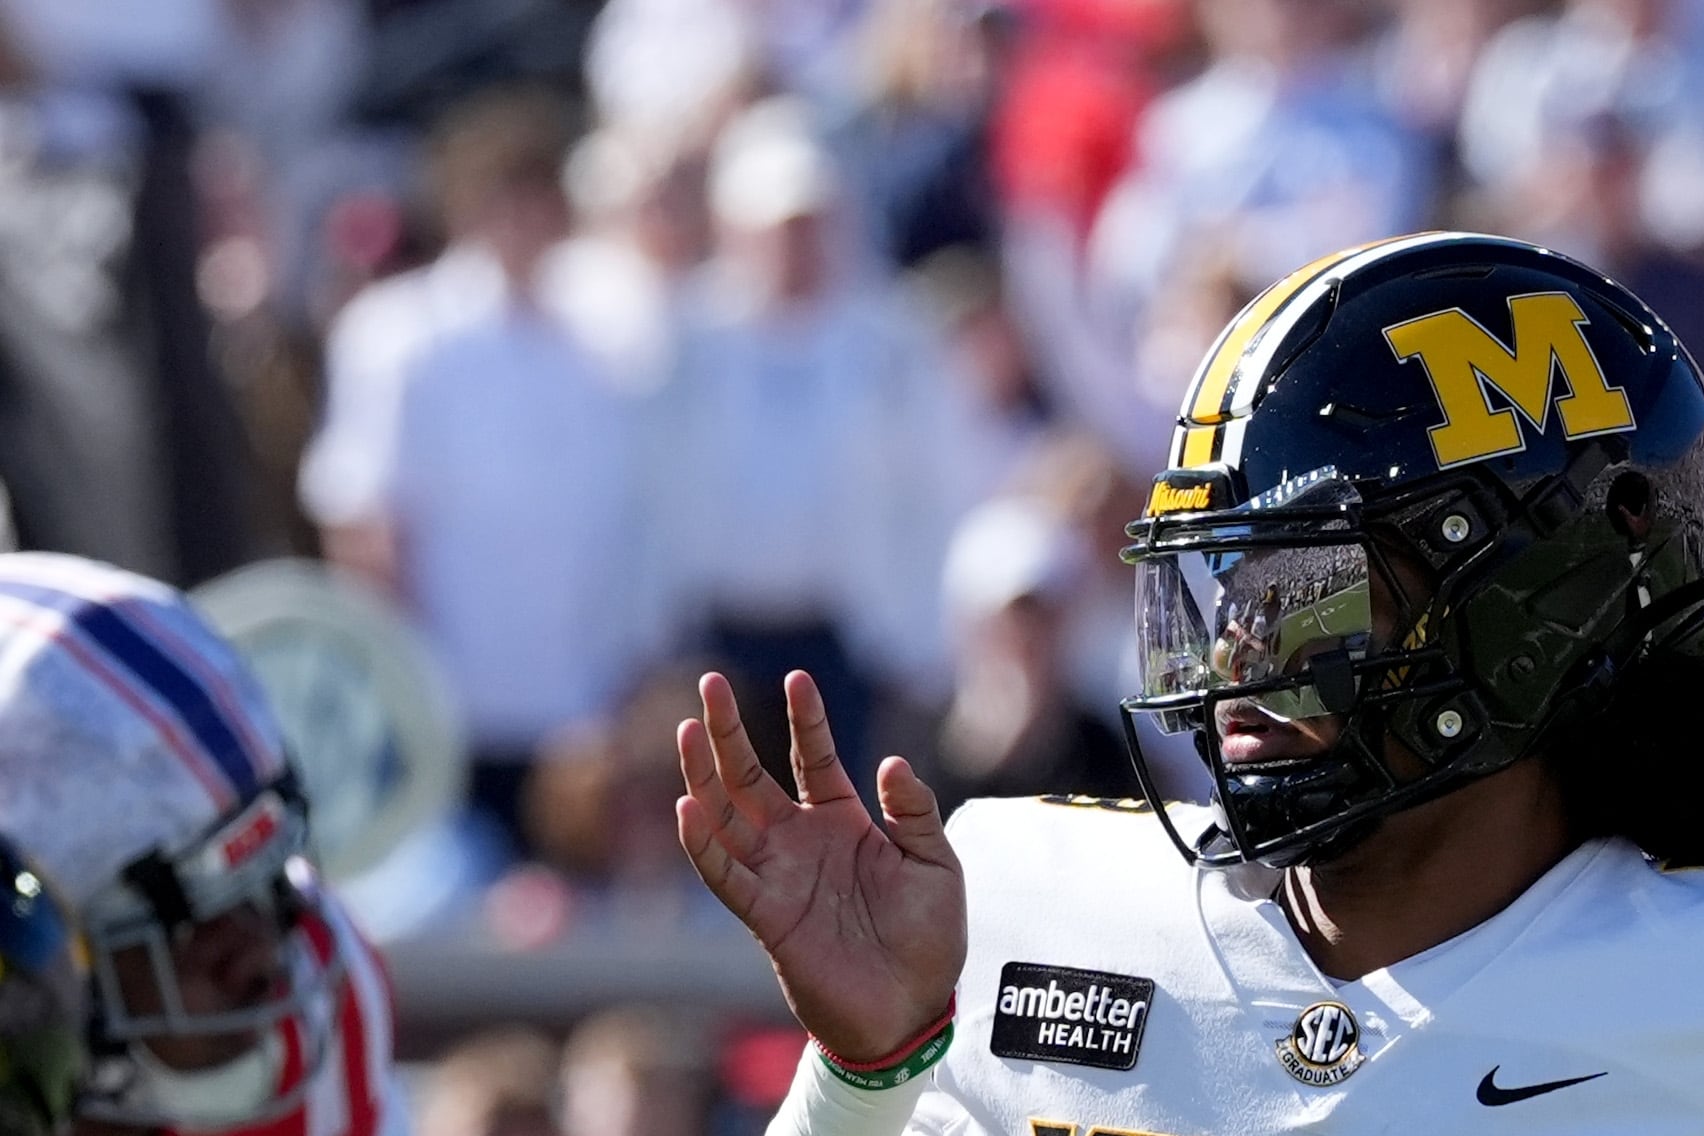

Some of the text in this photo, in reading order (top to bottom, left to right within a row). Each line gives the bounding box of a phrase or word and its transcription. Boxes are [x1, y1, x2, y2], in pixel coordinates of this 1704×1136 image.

[1382, 291, 1638, 470] M
[1146, 481, 1213, 517] Missouri
[999, 979, 1147, 1030] ambetter
[1038, 1021, 1133, 1055] HEALTH
[1297, 1004, 1355, 1063] SEC
[1282, 1052, 1350, 1084] GRADUATE
